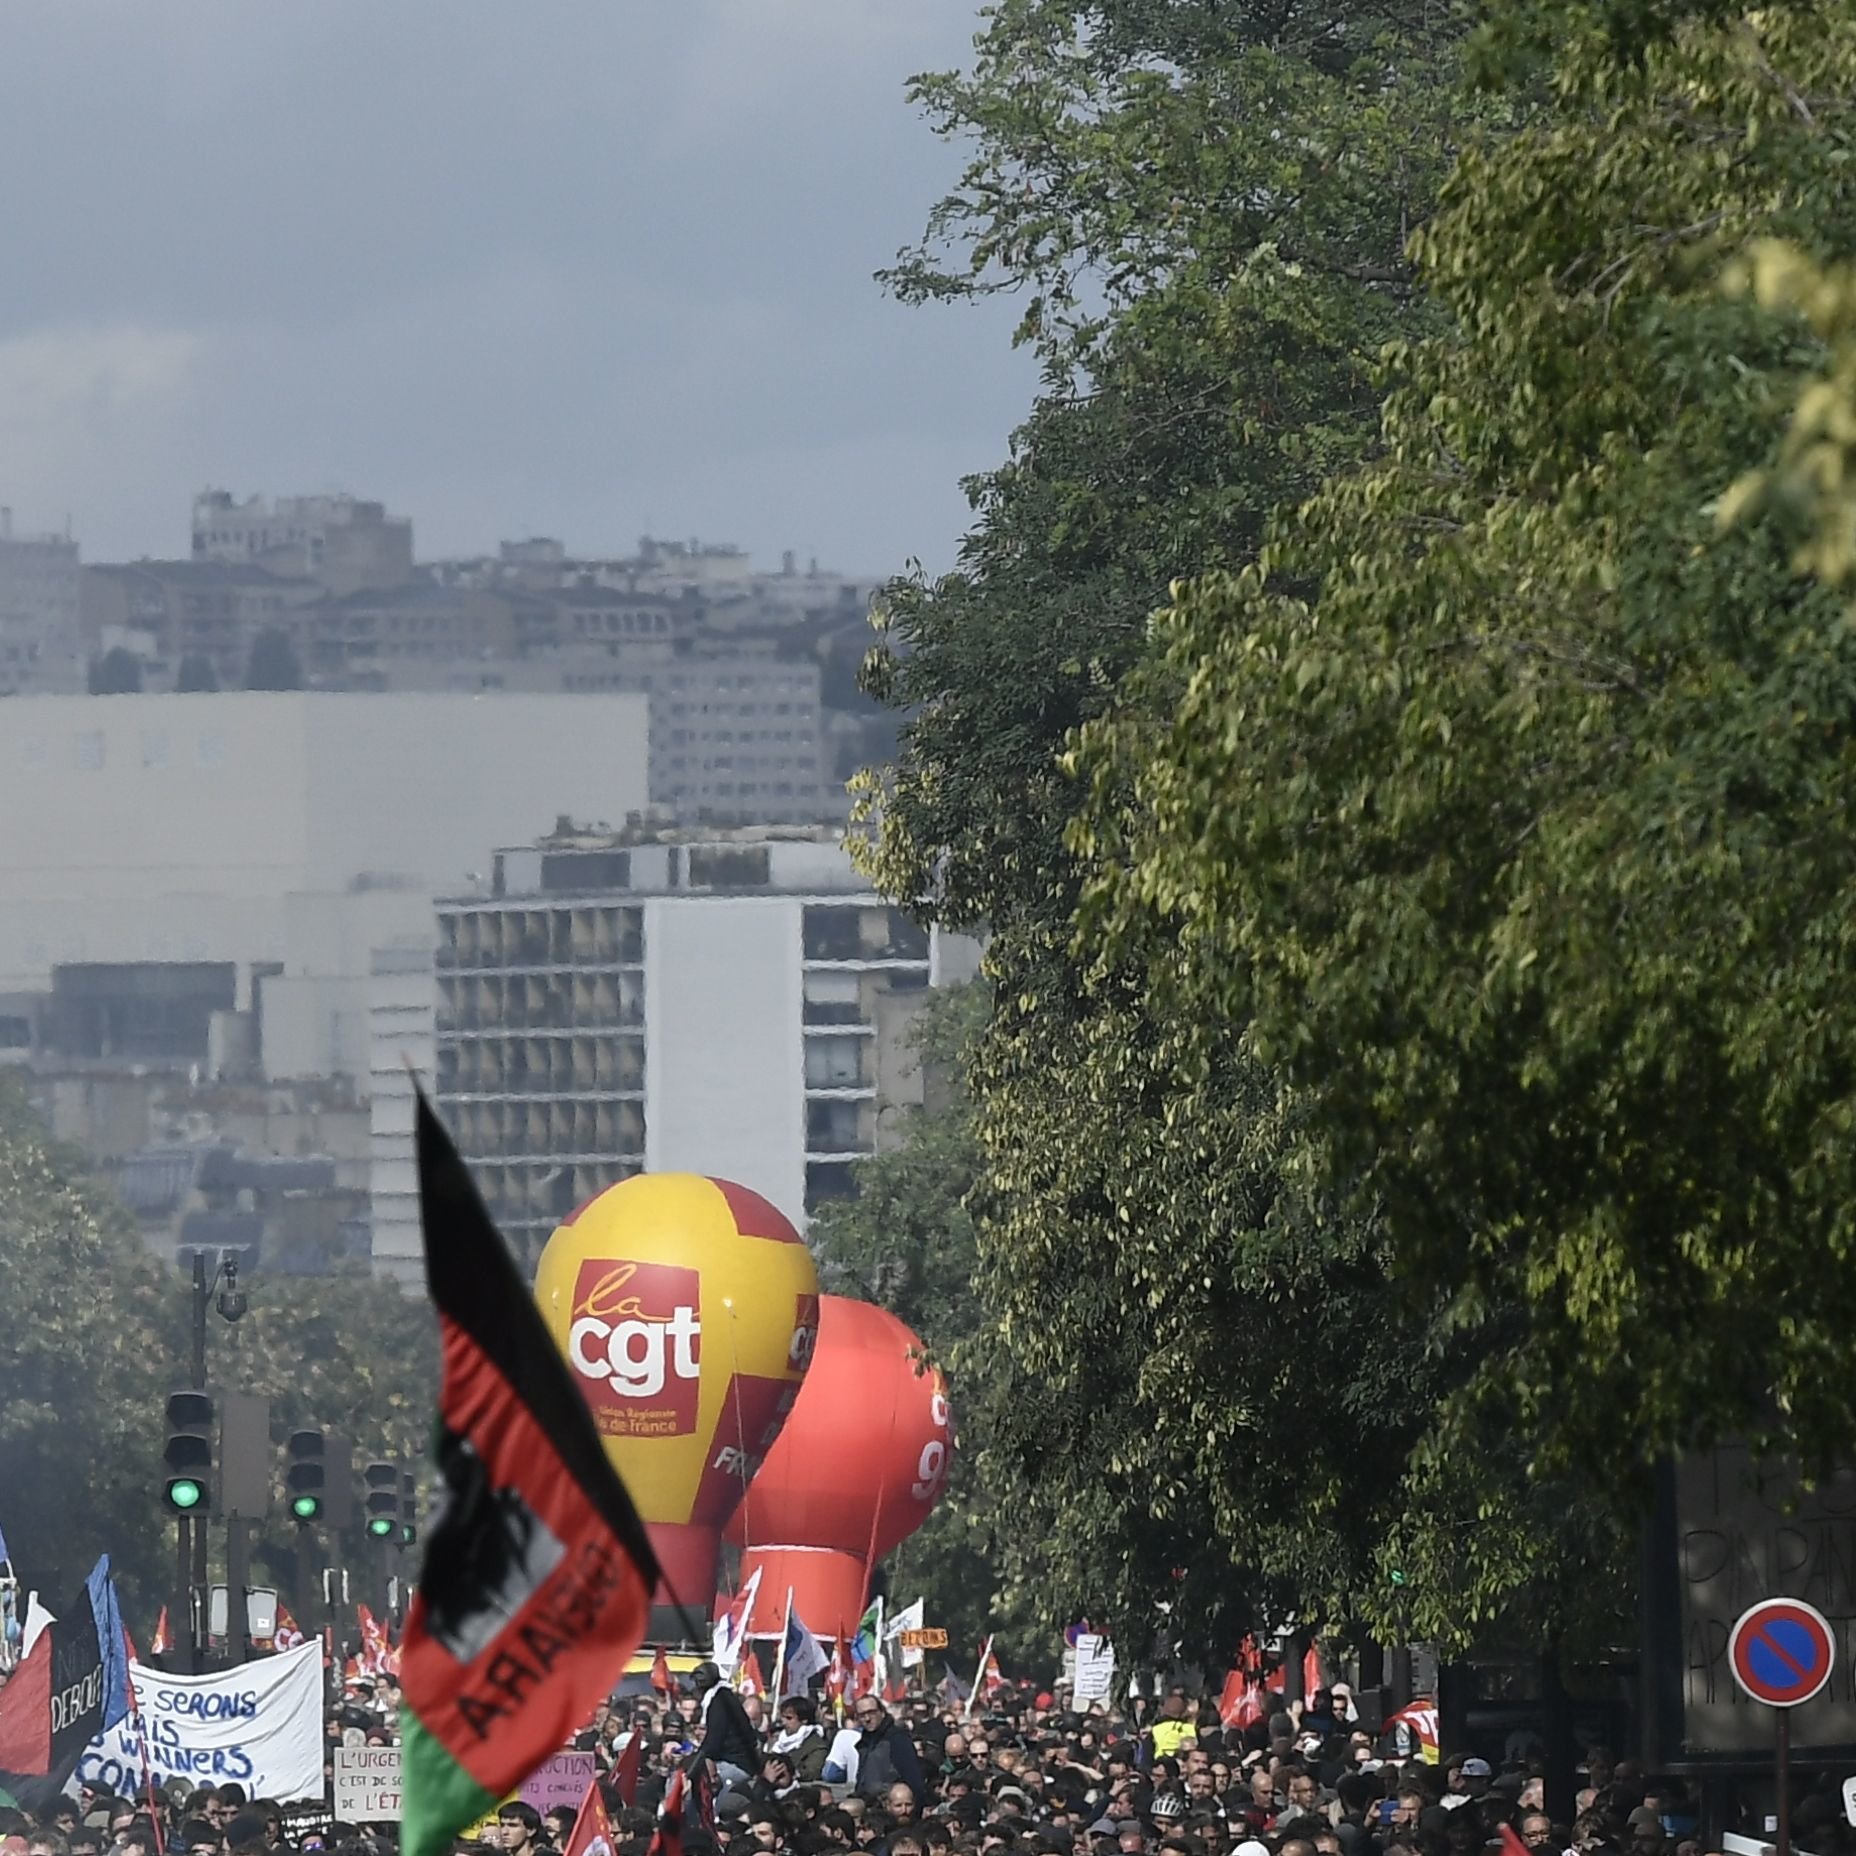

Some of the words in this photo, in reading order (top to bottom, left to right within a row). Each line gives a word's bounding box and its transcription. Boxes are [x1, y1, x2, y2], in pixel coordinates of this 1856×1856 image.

[569, 1307, 700, 1397] cgt
[630, 1421, 677, 1432] France
[50, 1663, 104, 1735] DEBOUT
